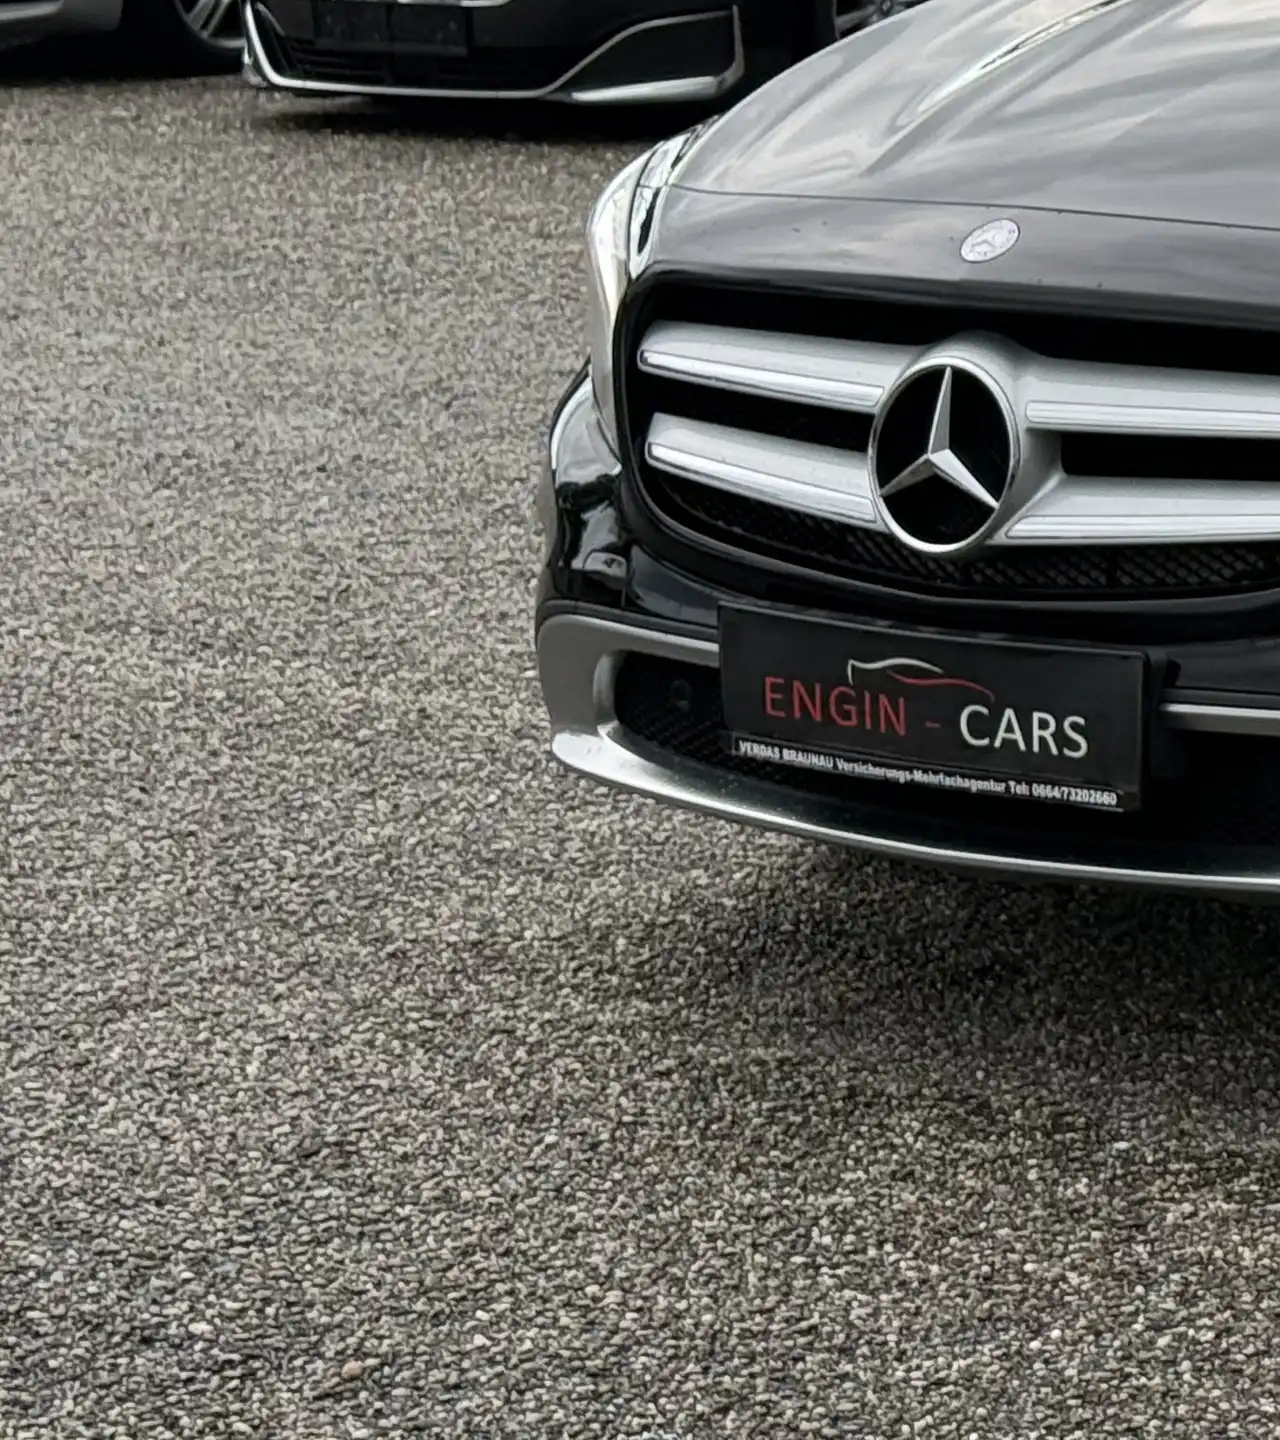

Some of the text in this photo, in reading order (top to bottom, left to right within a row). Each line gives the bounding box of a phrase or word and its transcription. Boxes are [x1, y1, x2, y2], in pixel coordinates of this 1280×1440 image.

[763, 676, 908, 737] ENGIN
[958, 702, 1090, 761] CARS
[739, 739, 780, 761] VERDAS
[782, 747, 834, 769] BRAUNAU
